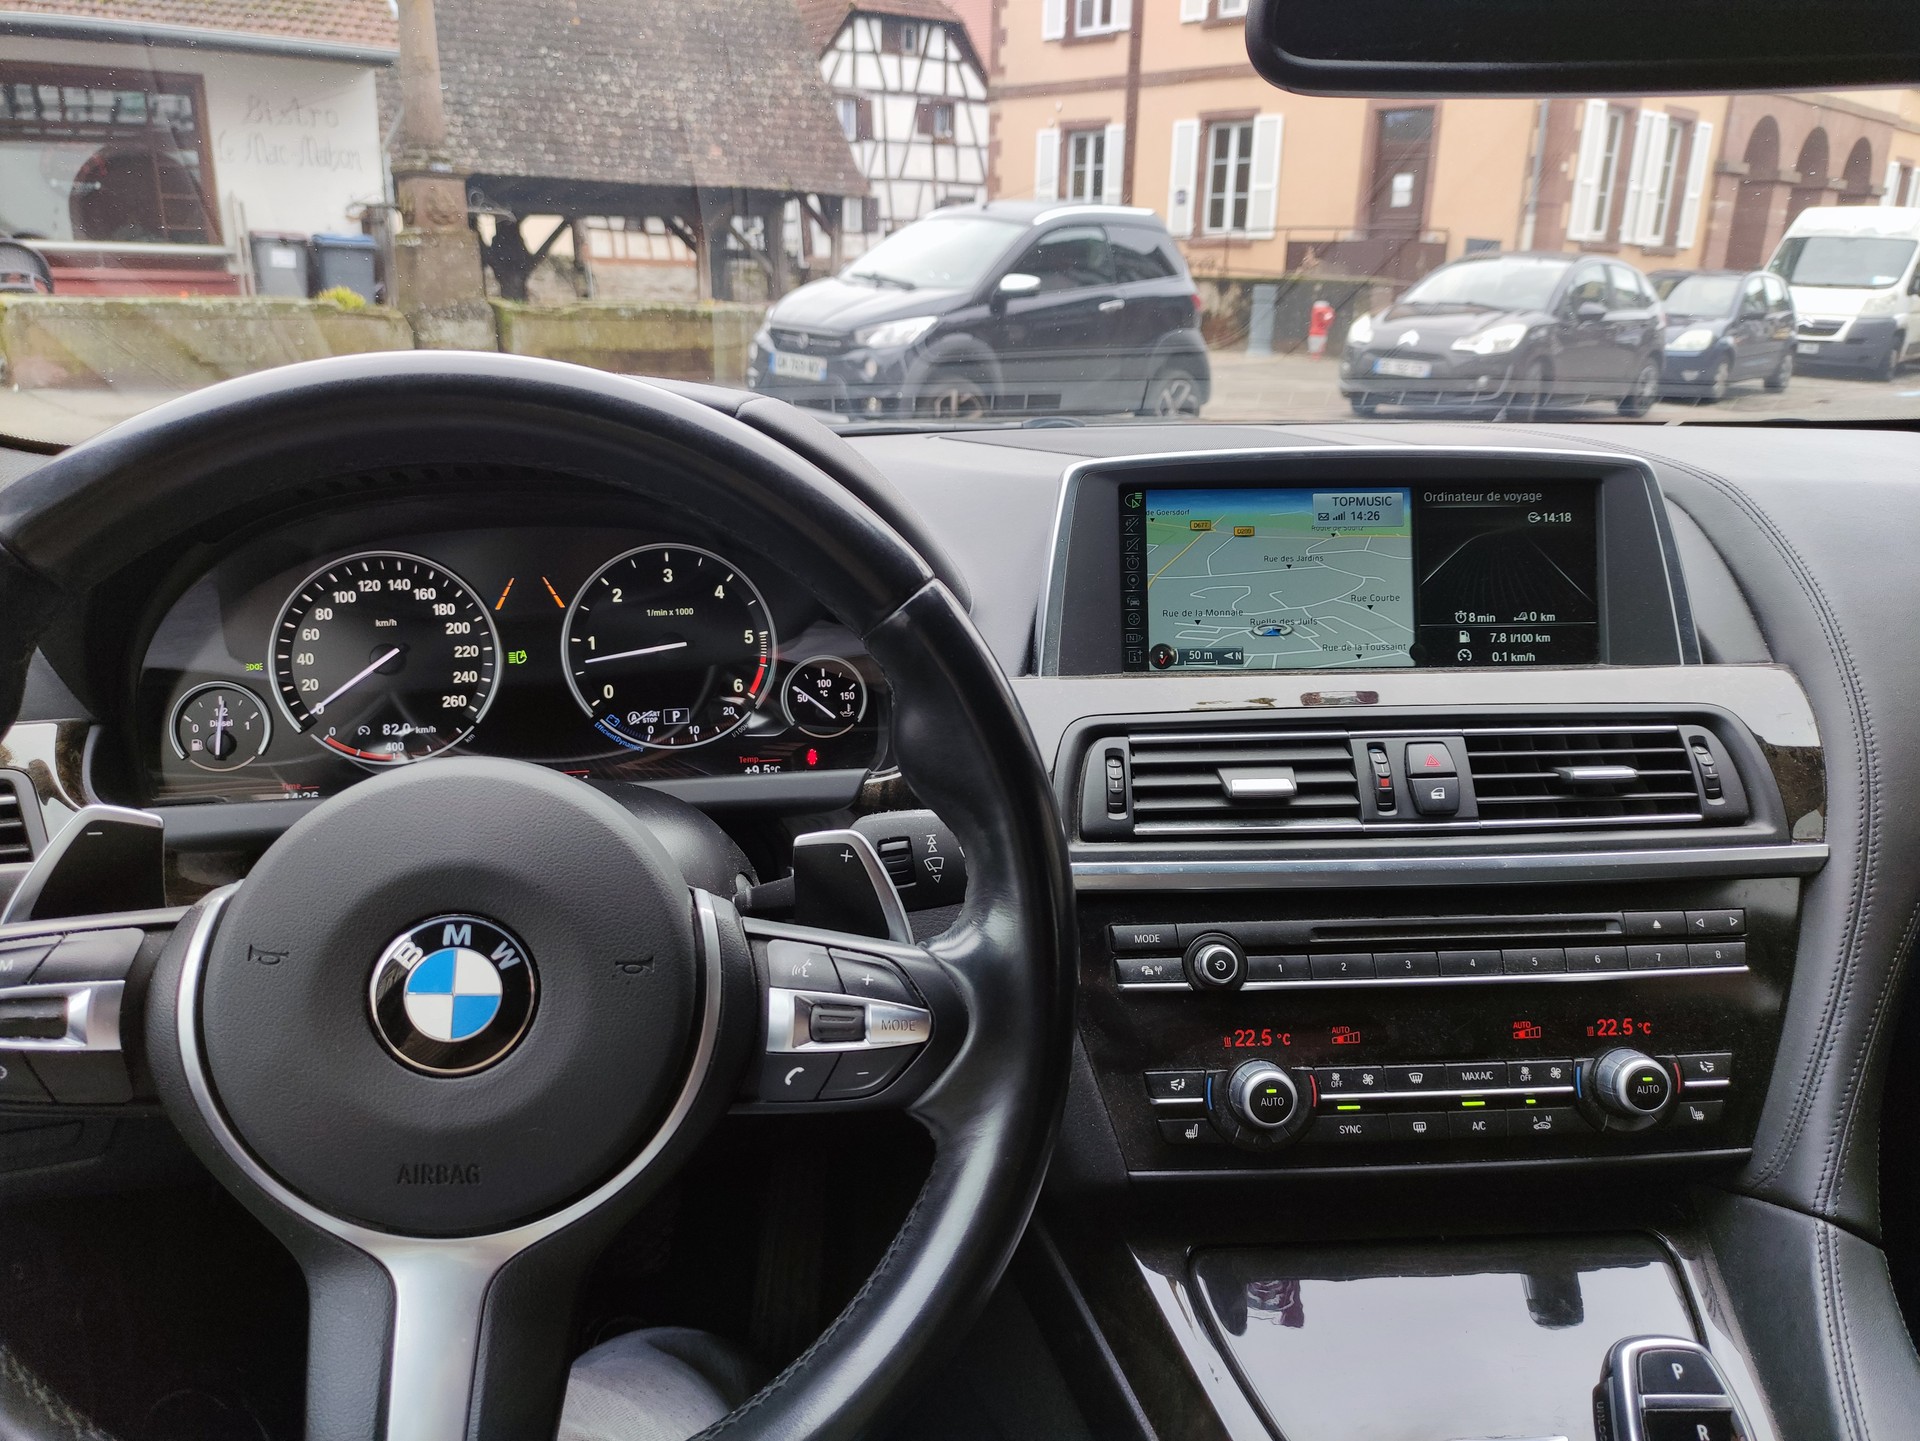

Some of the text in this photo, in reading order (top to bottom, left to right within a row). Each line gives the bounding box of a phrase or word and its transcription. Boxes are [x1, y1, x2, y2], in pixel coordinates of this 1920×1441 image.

[1332, 496, 1392, 507] TOPMUSIC
[1424, 491, 1543, 503] Ordinateur de voyage
[1350, 511, 1381, 522] 14:26
[1543, 512, 1572, 523] 14:18
[1296, 554, 1324, 562] Jardins
[663, 568, 674, 583] 3
[358, 579, 382, 592] 120
[388, 578, 411, 592] 140
[333, 590, 357, 603] 100
[413, 588, 436, 600] 160
[612, 588, 623, 603] 2
[714, 584, 725, 599] 4
[1350, 593, 1400, 602] Rue Courbe
[315, 608, 333, 621] 80
[432, 603, 456, 616] 180
[646, 608, 668, 617] 1/min
[675, 608, 694, 616] 1000
[1162, 608, 1244, 618] Rue de la Monnaie
[1298, 618, 1318, 626] Juifs
[1468, 612, 1496, 622] 8 min
[1530, 612, 1556, 622] 0 km
[375, 618, 398, 628] km/h
[446, 622, 470, 634] 200
[302, 628, 320, 641] 60
[744, 630, 754, 644] 5
[1490, 632, 1507, 643] 7.8
[1536, 633, 1551, 643] km
[588, 636, 596, 650] 1
[1322, 642, 1406, 652] Rue de la Toussaint
[454, 645, 479, 658] 220
[1188, 650, 1201, 660] 50
[1235, 652, 1242, 660] N
[296, 652, 314, 666] 40
[1492, 652, 1536, 662] 0.1 km/h
[452, 671, 478, 684] 240
[302, 678, 319, 692] 20
[733, 678, 744, 693] 6
[816, 678, 832, 688] 100
[603, 684, 614, 699] 0
[820, 689, 829, 698] °C
[840, 691, 856, 701] 150
[442, 695, 467, 708] 260
[797, 694, 808, 703] 50
[315, 702, 326, 716] 0
[722, 706, 735, 716] 20
[672, 710, 681, 722] P
[209, 718, 234, 728] Disel
[244, 722, 251, 731] 1
[192, 724, 200, 734] 0
[328, 727, 336, 737] 0
[415, 726, 437, 735] km/h
[648, 726, 654, 734] 0
[688, 726, 700, 735] 10
[385, 742, 405, 752] 400
[738, 756, 760, 764] Temp
[1134, 934, 1161, 944] MODE
[393, 923, 521, 971] BMW
[1594, 954, 1601, 964] 6
[1656, 952, 1662, 962] 7
[1715, 950, 1722, 960] 8
[1340, 962, 1347, 972] 2
[1404, 960, 1412, 970] 3
[1470, 958, 1476, 968] 4
[1532, 957, 1538, 967] 5
[1278, 964, 1283, 973] 1
[880, 1018, 917, 1032] MODE
[1332, 1026, 1350, 1034] AUTO
[1513, 1021, 1532, 1029] AUTO
[1596, 1018, 1652, 1036] 22.5 °C
[1234, 1028, 1292, 1048] 22.5 °C
[1462, 1070, 1494, 1081] MAX A/C
[1520, 1073, 1532, 1082] OFF
[1330, 1080, 1344, 1088] OFF
[1636, 1084, 1660, 1095] AUTO
[1260, 1096, 1284, 1107] AUTO
[1338, 1124, 1362, 1135] SYNC
[1472, 1120, 1486, 1131] A/C
[396, 1162, 481, 1186] AIRBAG
[1671, 1362, 1684, 1381] P
[1696, 1424, 1710, 1441] R
